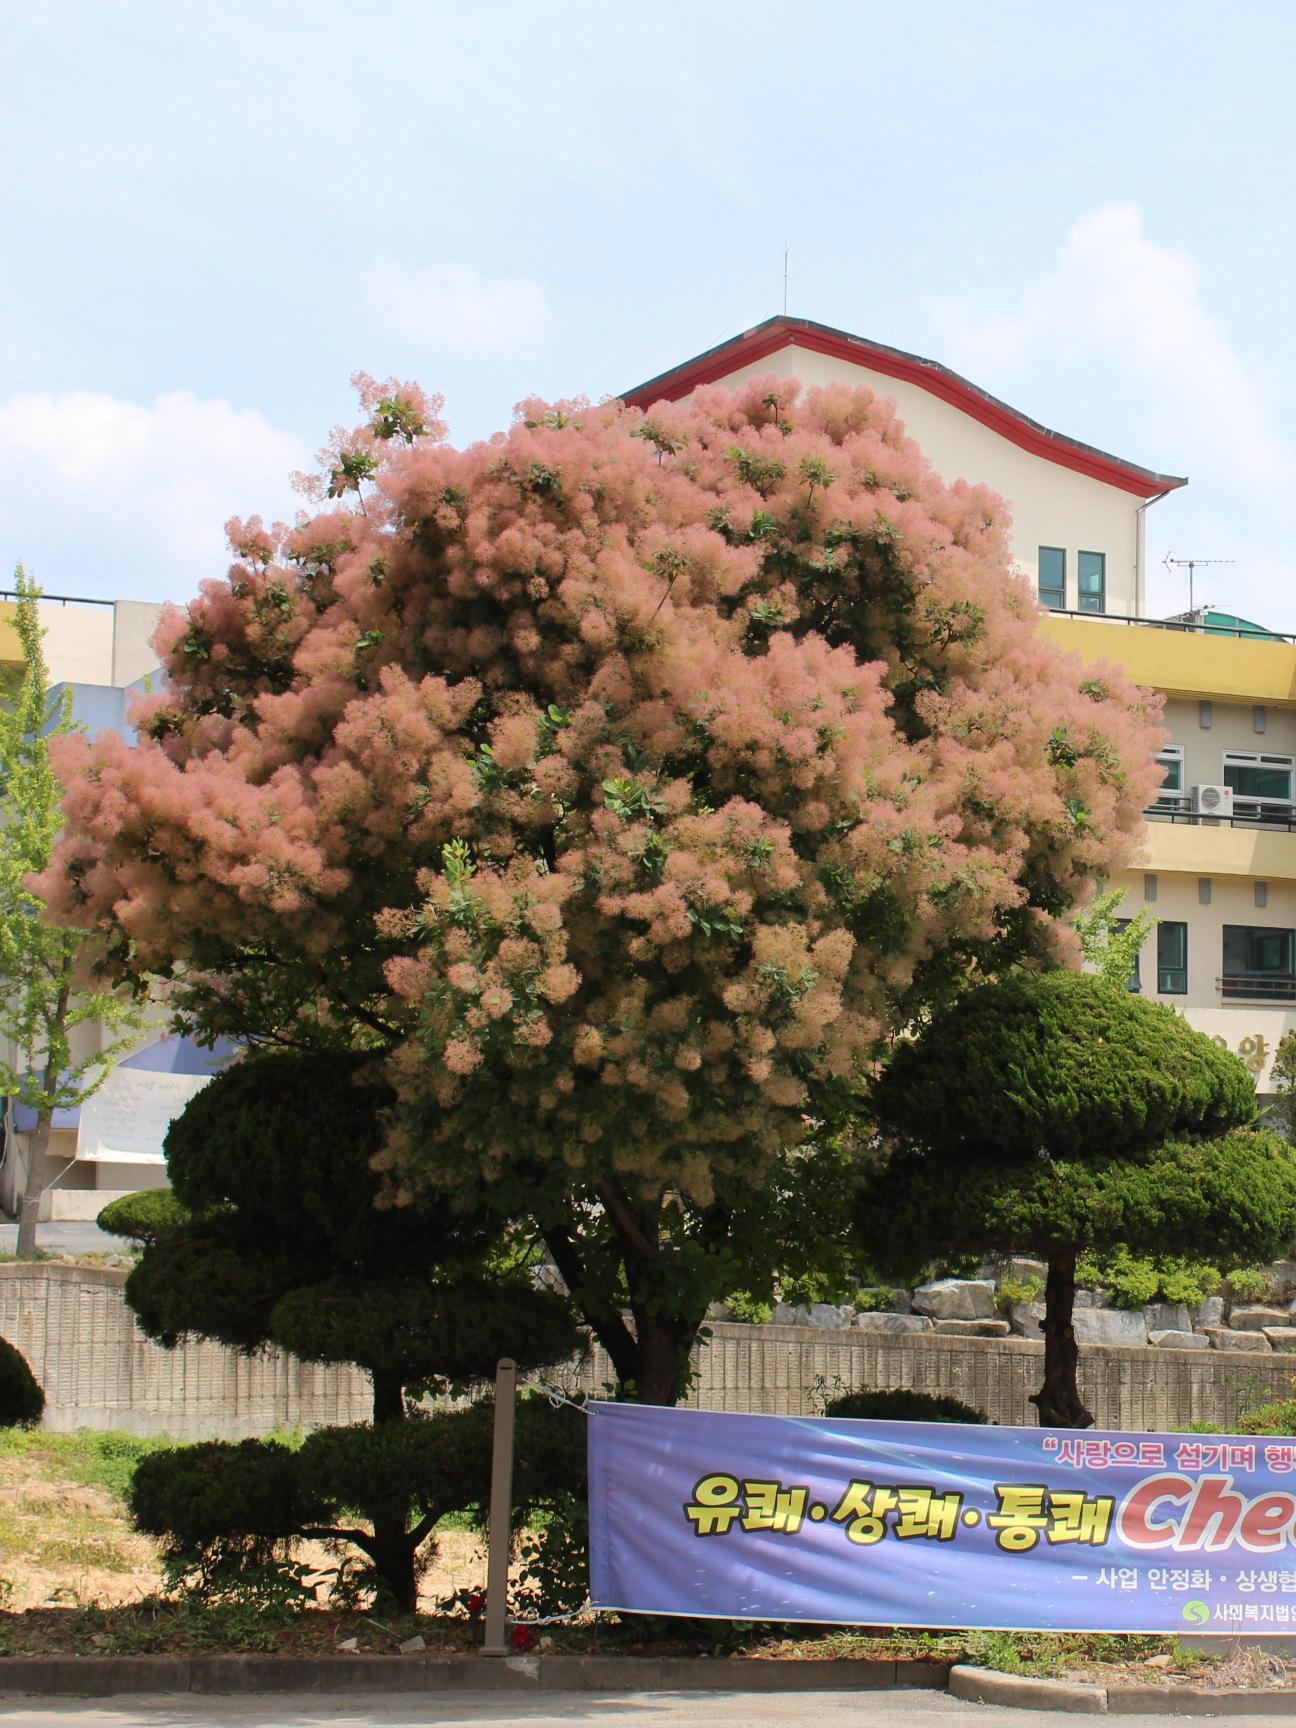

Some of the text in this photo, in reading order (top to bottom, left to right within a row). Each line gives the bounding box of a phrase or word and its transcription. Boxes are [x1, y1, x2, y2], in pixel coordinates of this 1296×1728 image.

[1174, 1444, 1255, 1472] 섬기며
[1096, 1567, 1139, 1589] 사업
[1147, 1568, 1212, 1591] 안정화
